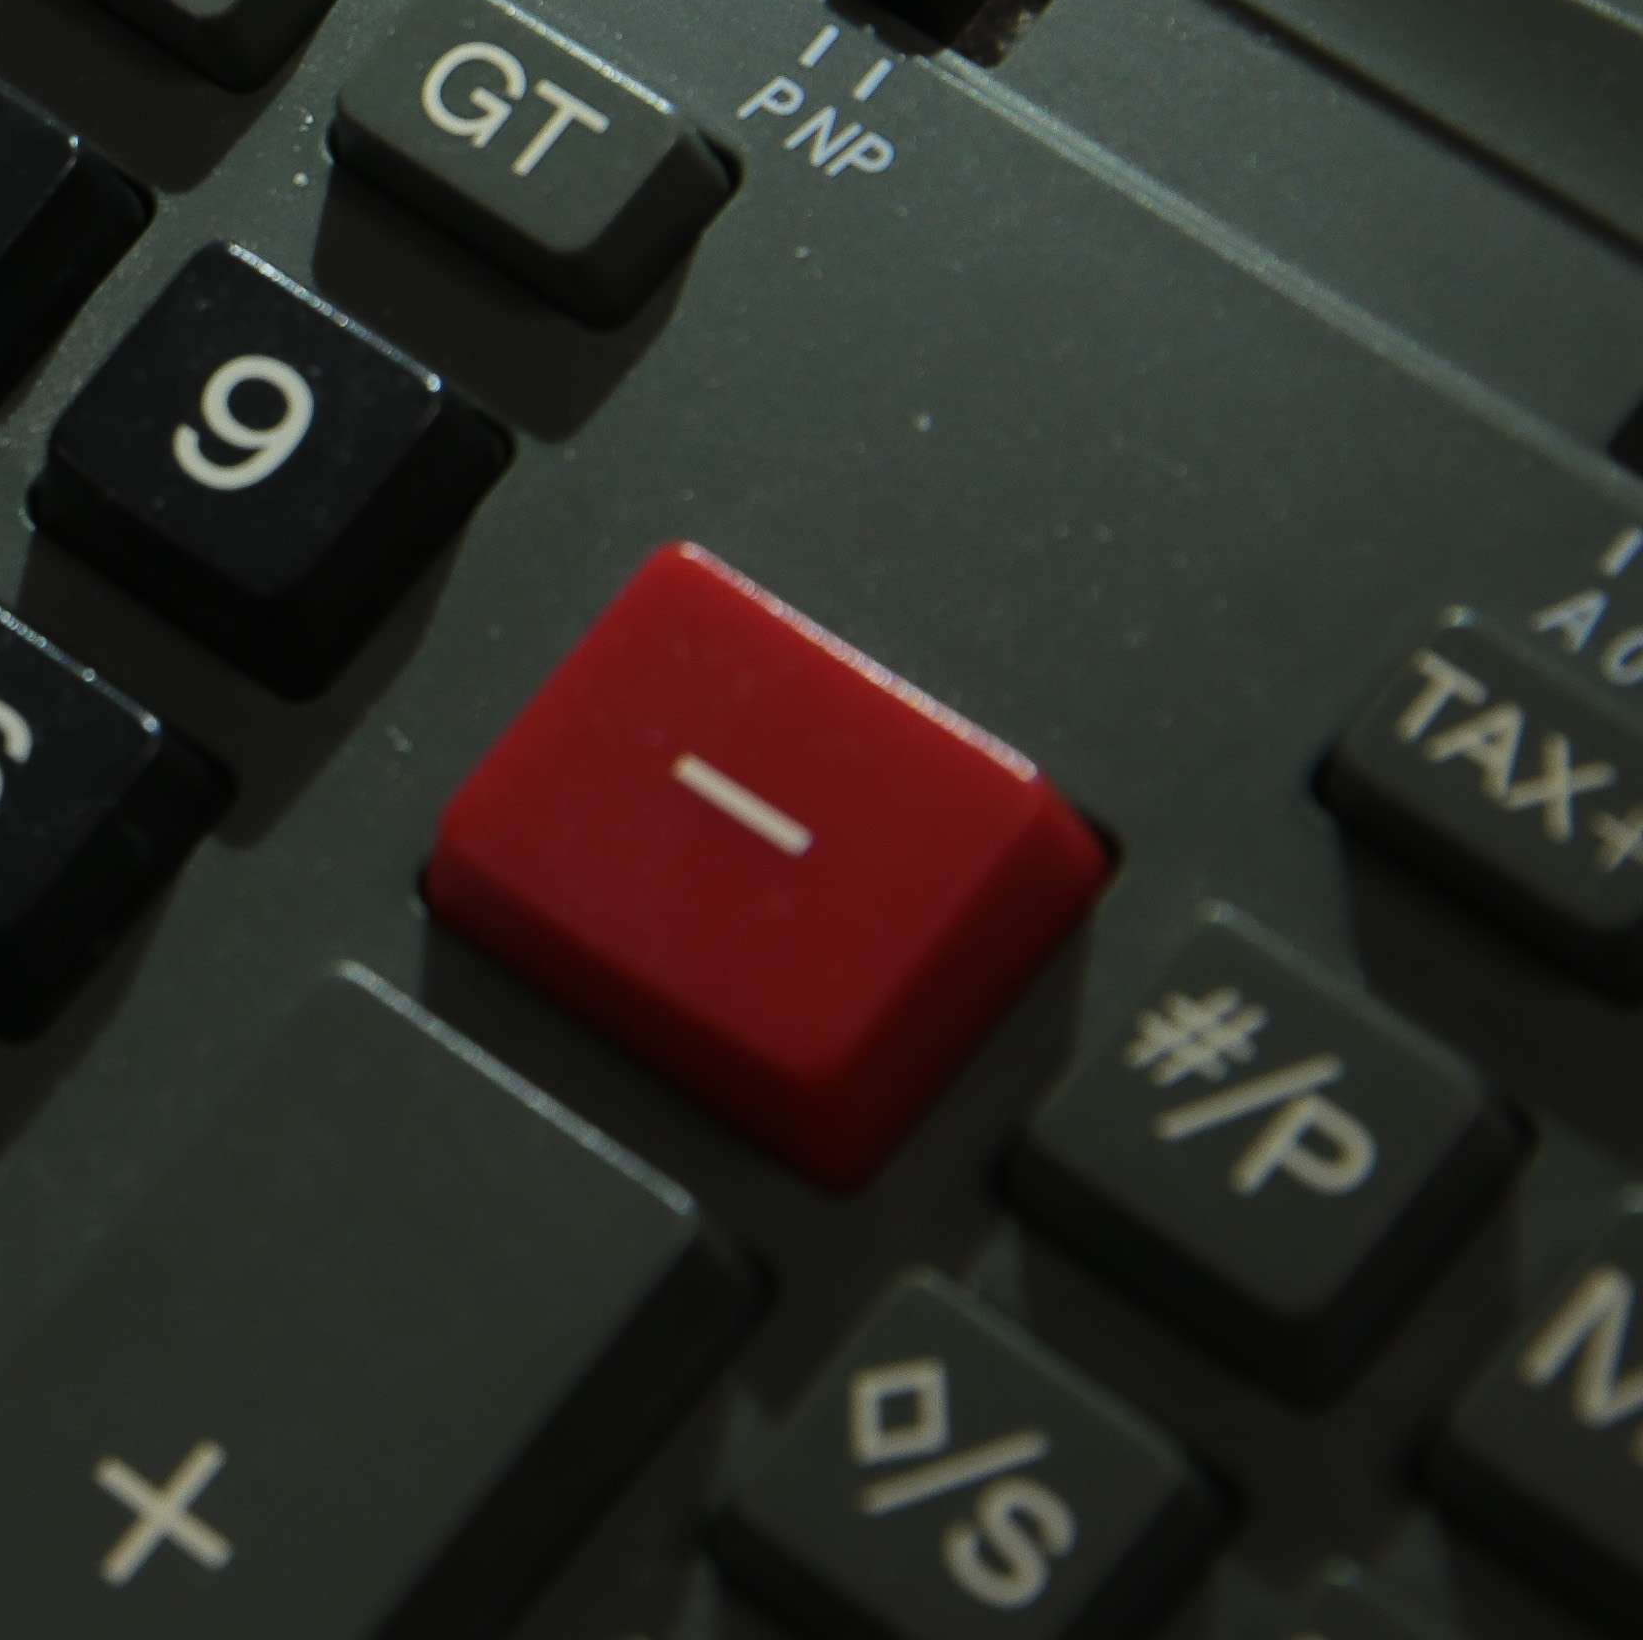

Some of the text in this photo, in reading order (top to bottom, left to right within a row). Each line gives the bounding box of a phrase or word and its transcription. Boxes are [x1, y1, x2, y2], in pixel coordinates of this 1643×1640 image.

[421, 41, 611, 175] GT
[735, 74, 896, 177] P NP
[173, 355, 314, 490] 9
[1529, 587, 1608, 654] A
[1121, 984, 1379, 1196] #/P
[97, 1443, 230, 1583] +
